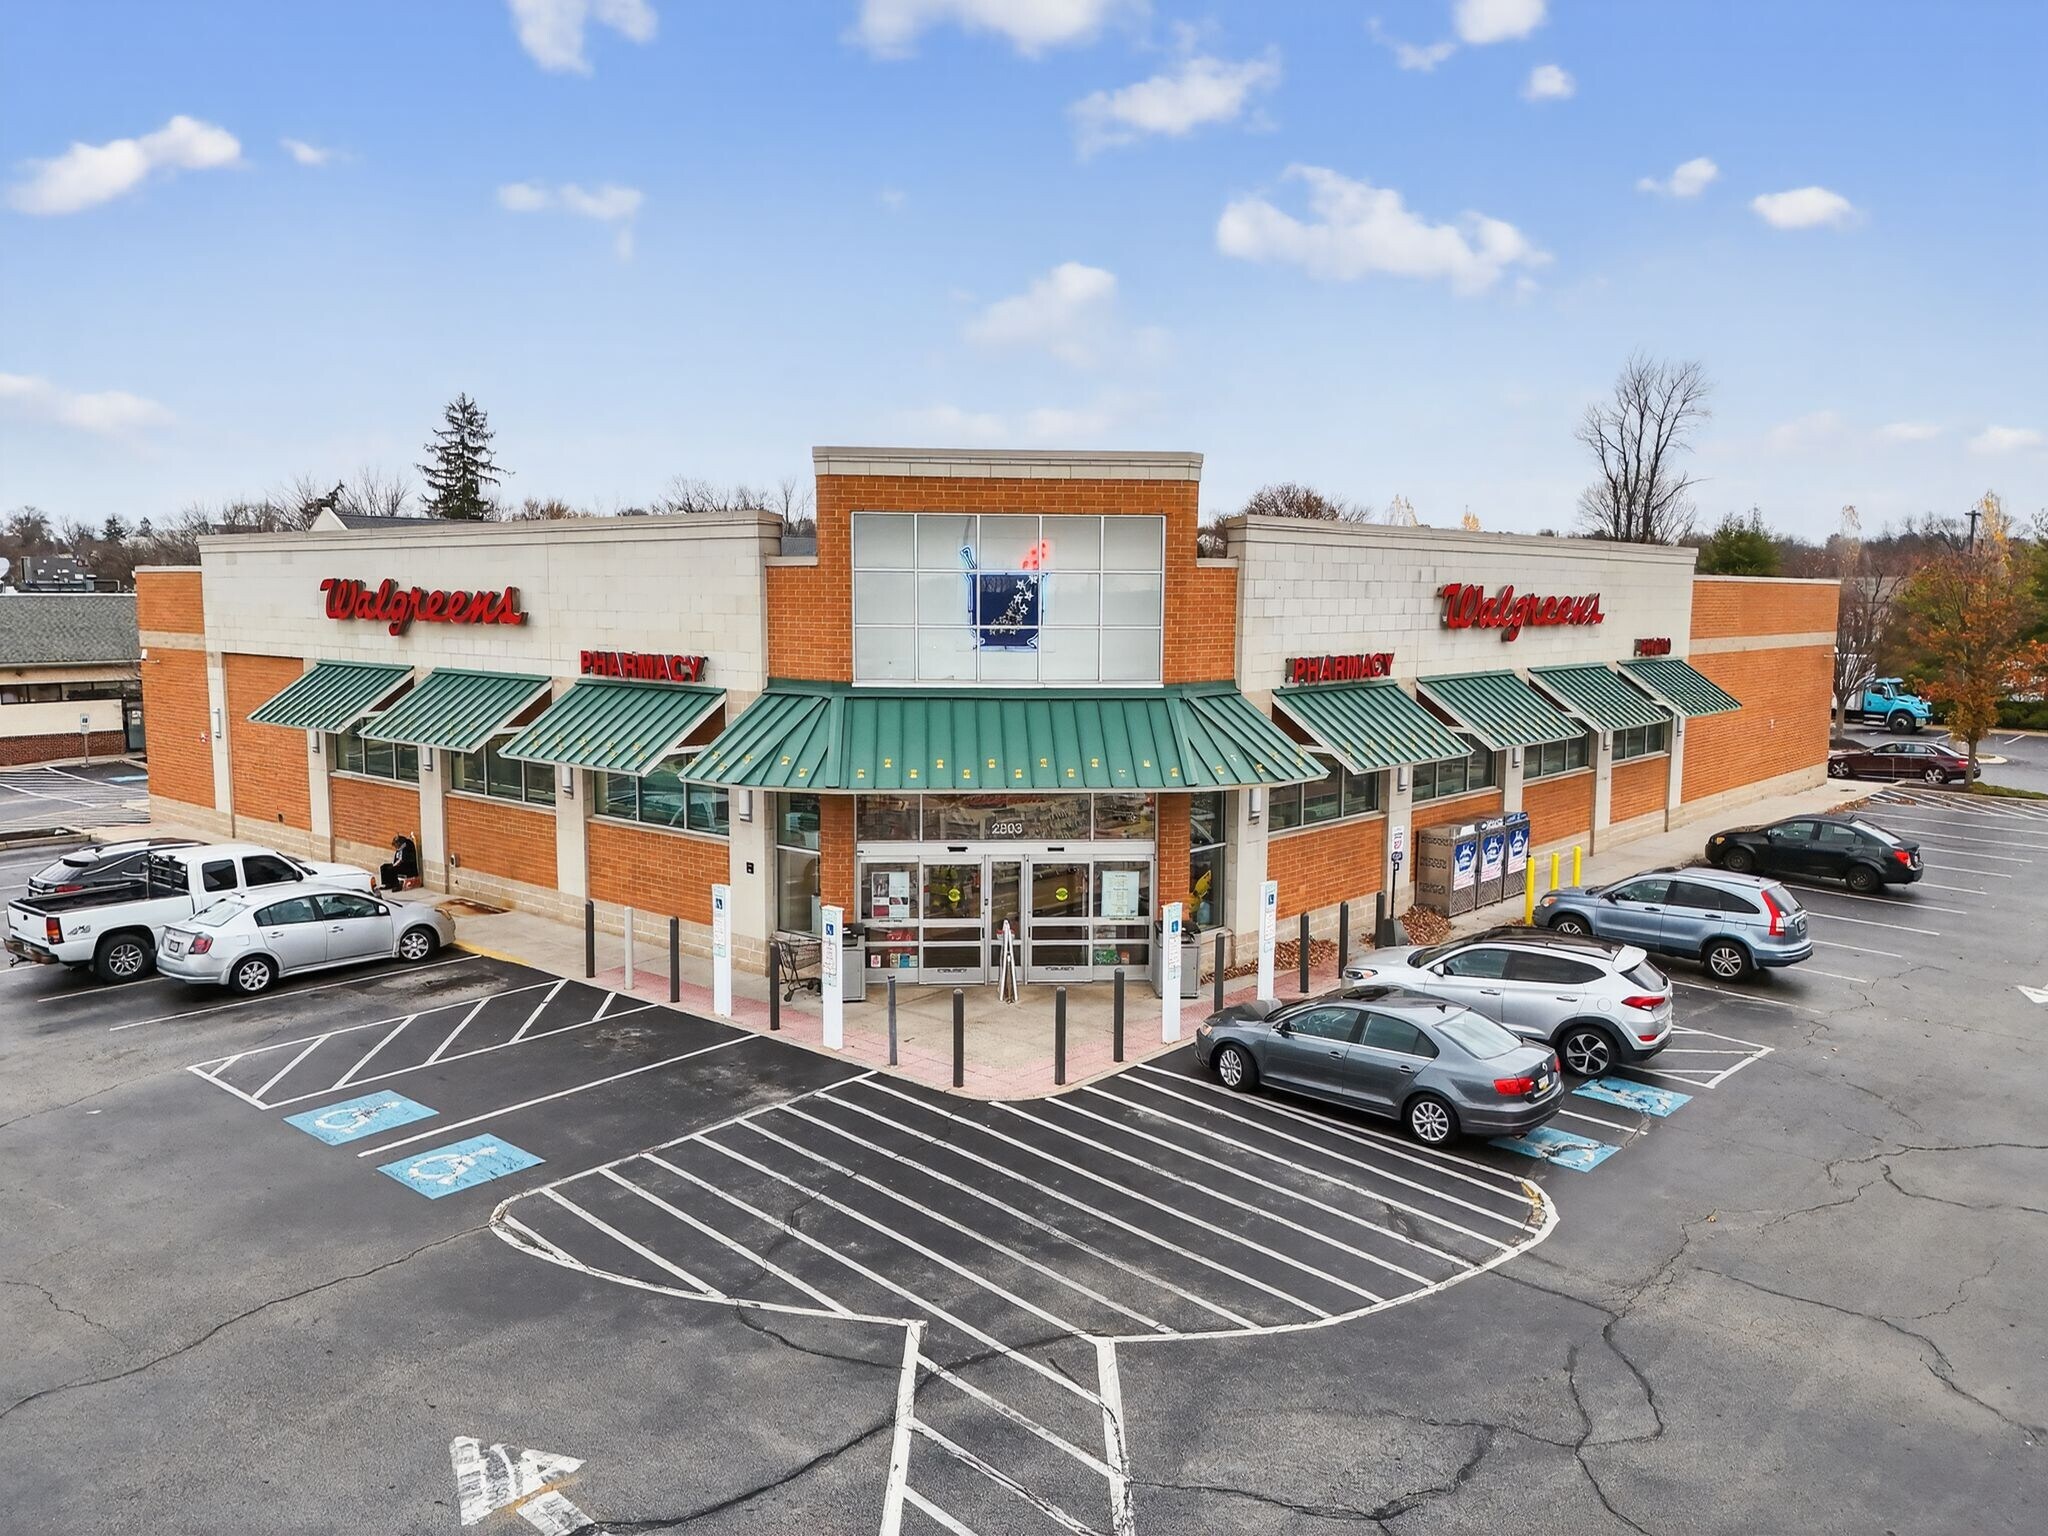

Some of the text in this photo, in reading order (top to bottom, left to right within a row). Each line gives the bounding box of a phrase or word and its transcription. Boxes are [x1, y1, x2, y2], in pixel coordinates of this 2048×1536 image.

[320, 578, 526, 636] Walgreens
[1440, 583, 1605, 642] Walgreens
[580, 651, 703, 683] PHARMACY
[1289, 652, 1395, 683] PHARMACY
[991, 822, 1023, 835] 2803
